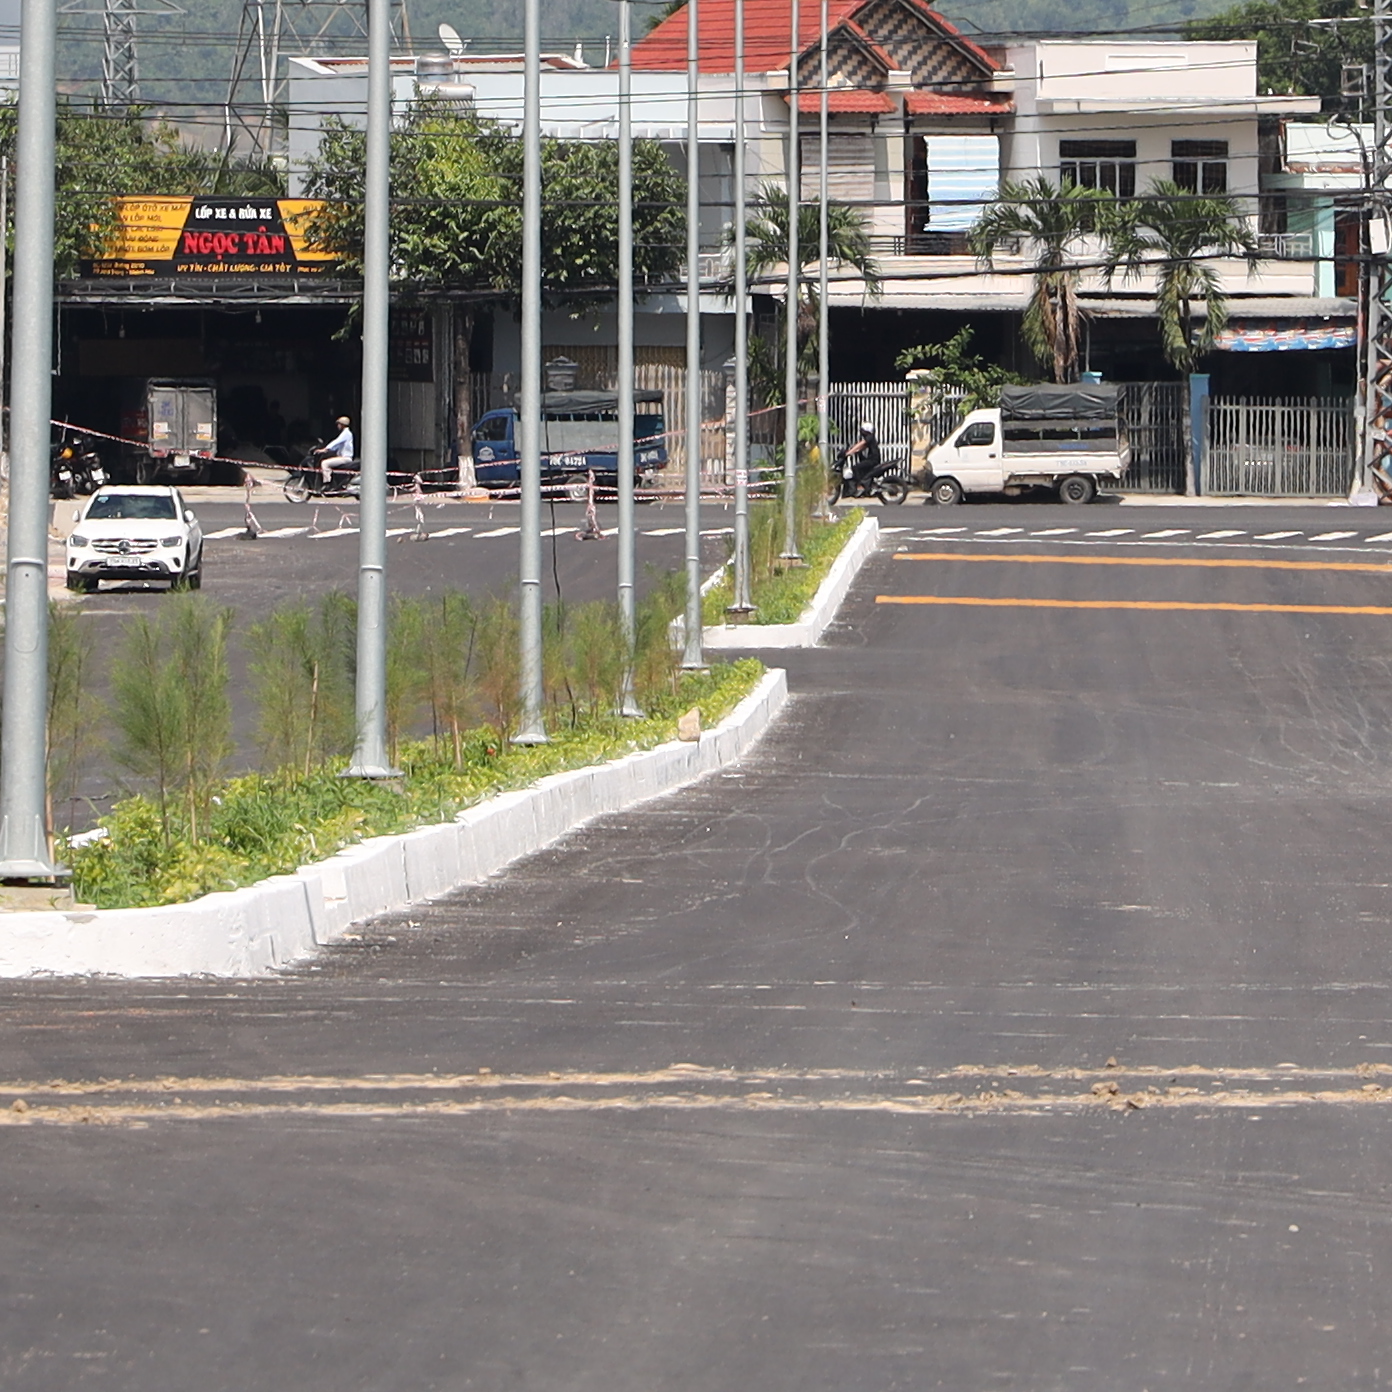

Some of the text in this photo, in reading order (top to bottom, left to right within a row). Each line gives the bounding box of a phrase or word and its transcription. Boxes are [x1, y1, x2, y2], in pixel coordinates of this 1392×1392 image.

[215, 207, 227, 219] XE
[259, 207, 272, 219] XE
[183, 232, 239, 260] NGỌC
